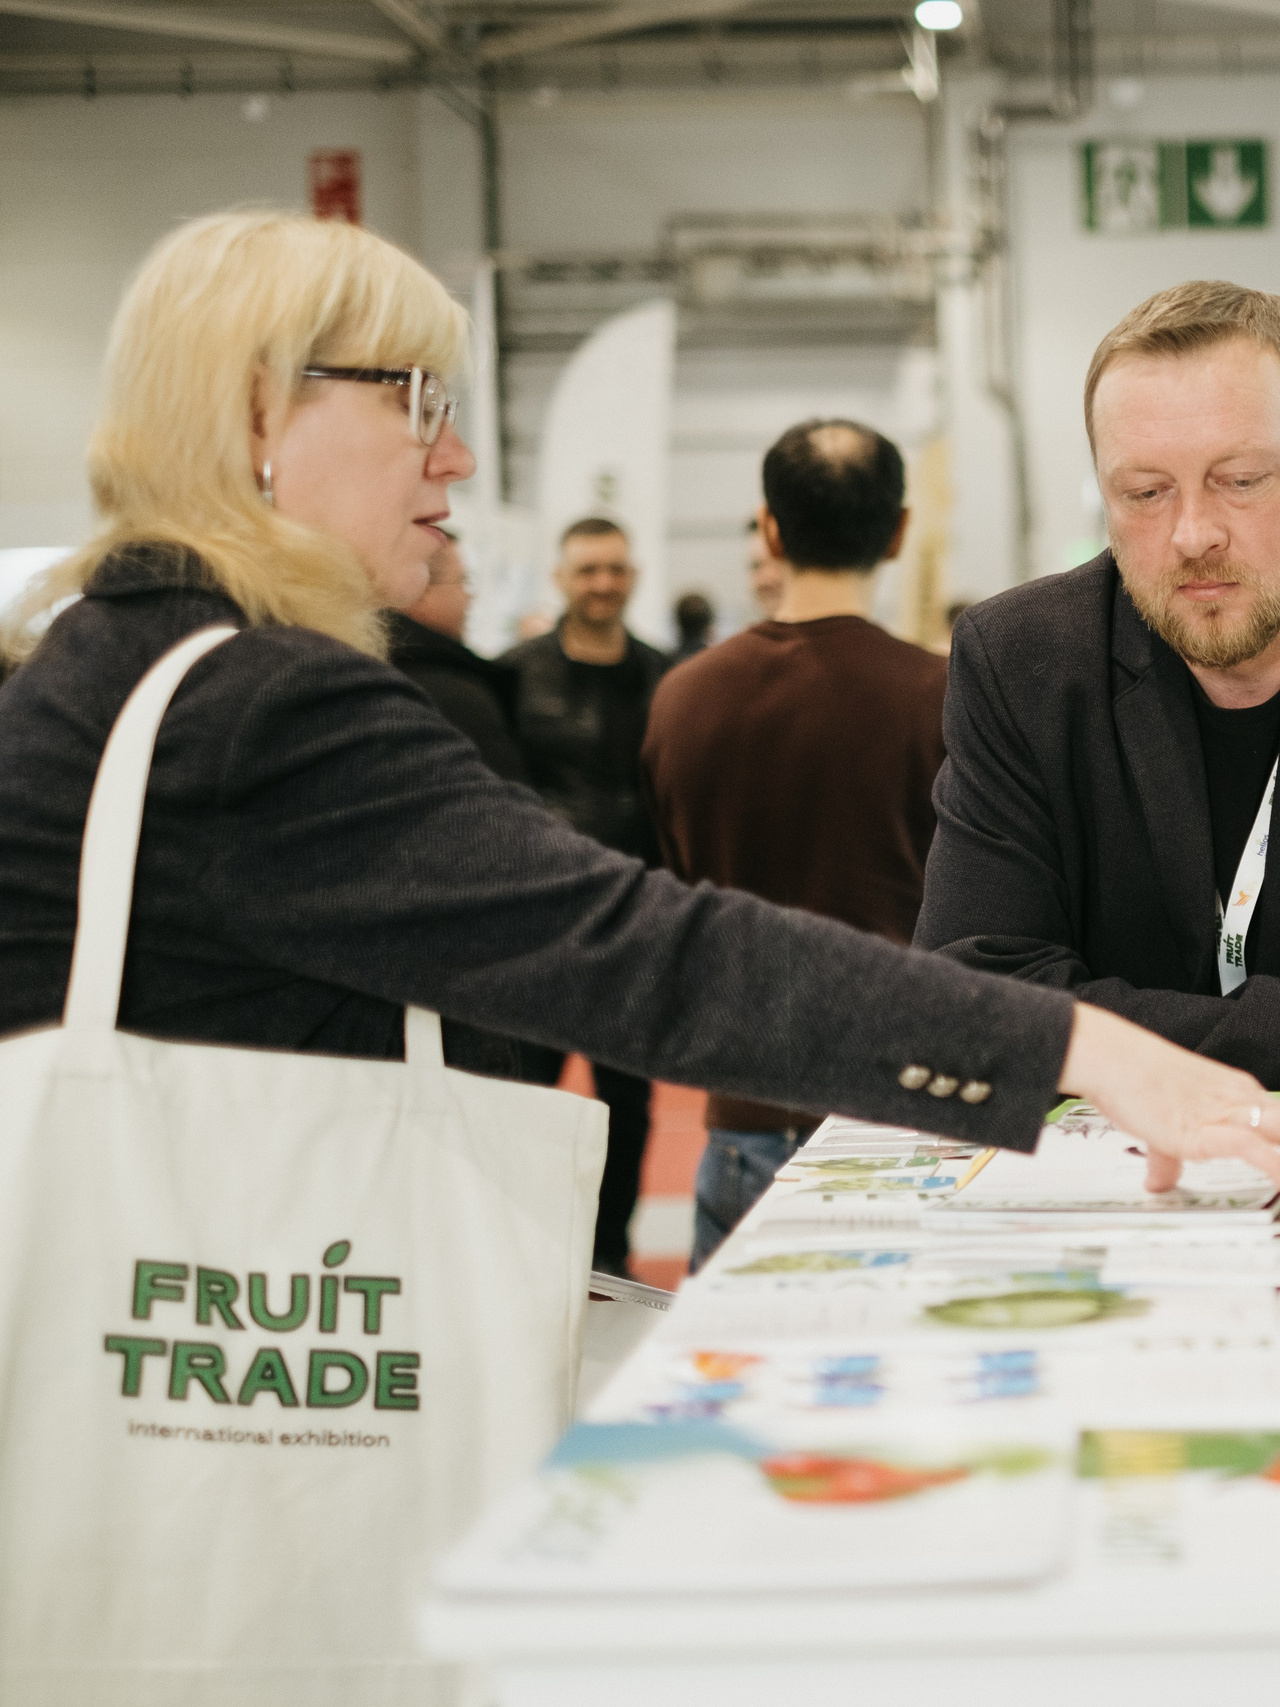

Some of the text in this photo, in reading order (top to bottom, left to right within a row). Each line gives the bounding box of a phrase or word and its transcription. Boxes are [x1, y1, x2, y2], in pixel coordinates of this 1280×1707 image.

[1223, 934, 1235, 965] FRUIT
[1234, 933, 1244, 968] TRADE
[131, 1238, 402, 1335] FRUIT
[103, 1333, 422, 1412] TRADE
[127, 1419, 391, 1450] international exhibition
